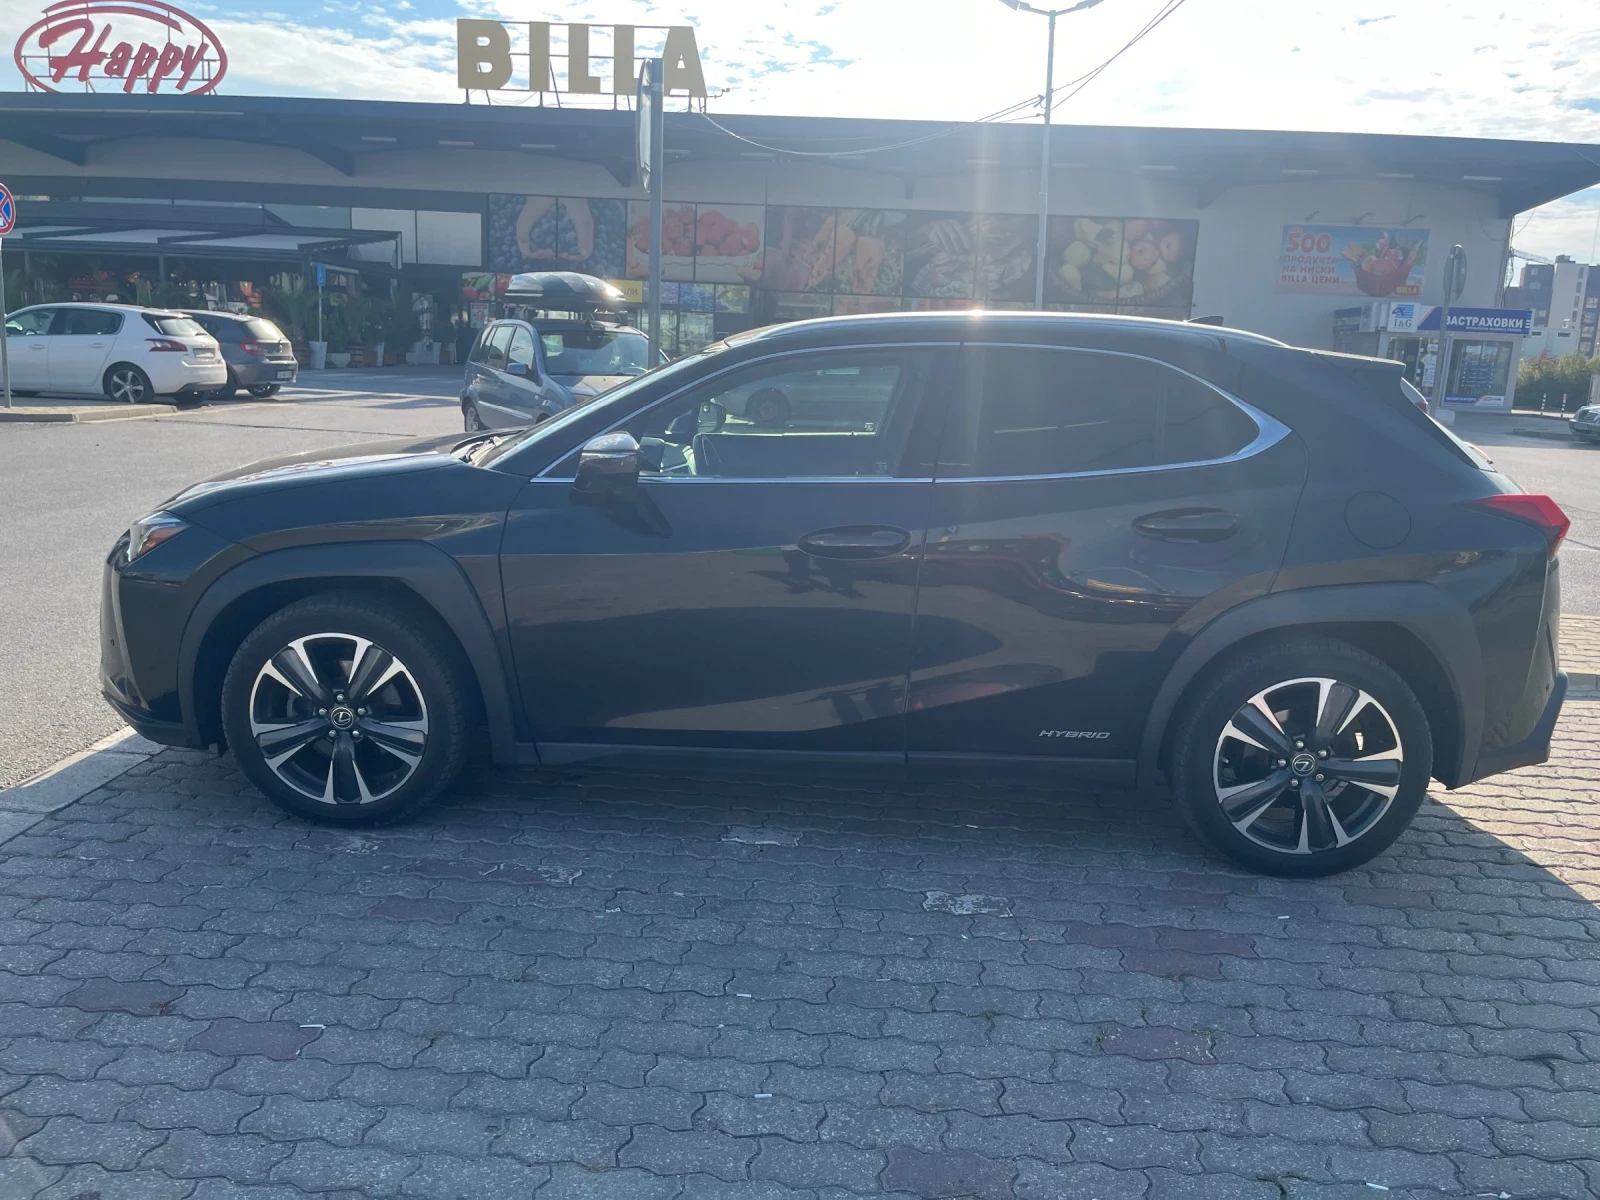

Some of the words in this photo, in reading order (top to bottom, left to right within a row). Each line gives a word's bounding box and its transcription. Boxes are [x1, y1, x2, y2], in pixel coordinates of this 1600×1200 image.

[38, 18, 210, 93] Happy
[457, 18, 708, 98] BILLA
[1285, 231, 1333, 254] 500
[1283, 254, 1338, 265] ПРОДУКТА
[1282, 264, 1296, 273] НА
[1300, 265, 1335, 275] НИСКИ
[1281, 274, 1308, 283] BILLA
[1311, 275, 1340, 285] ЦЕНИ
[1394, 318, 1412, 328] I&G
[1038, 730, 1111, 739] HYBRID
